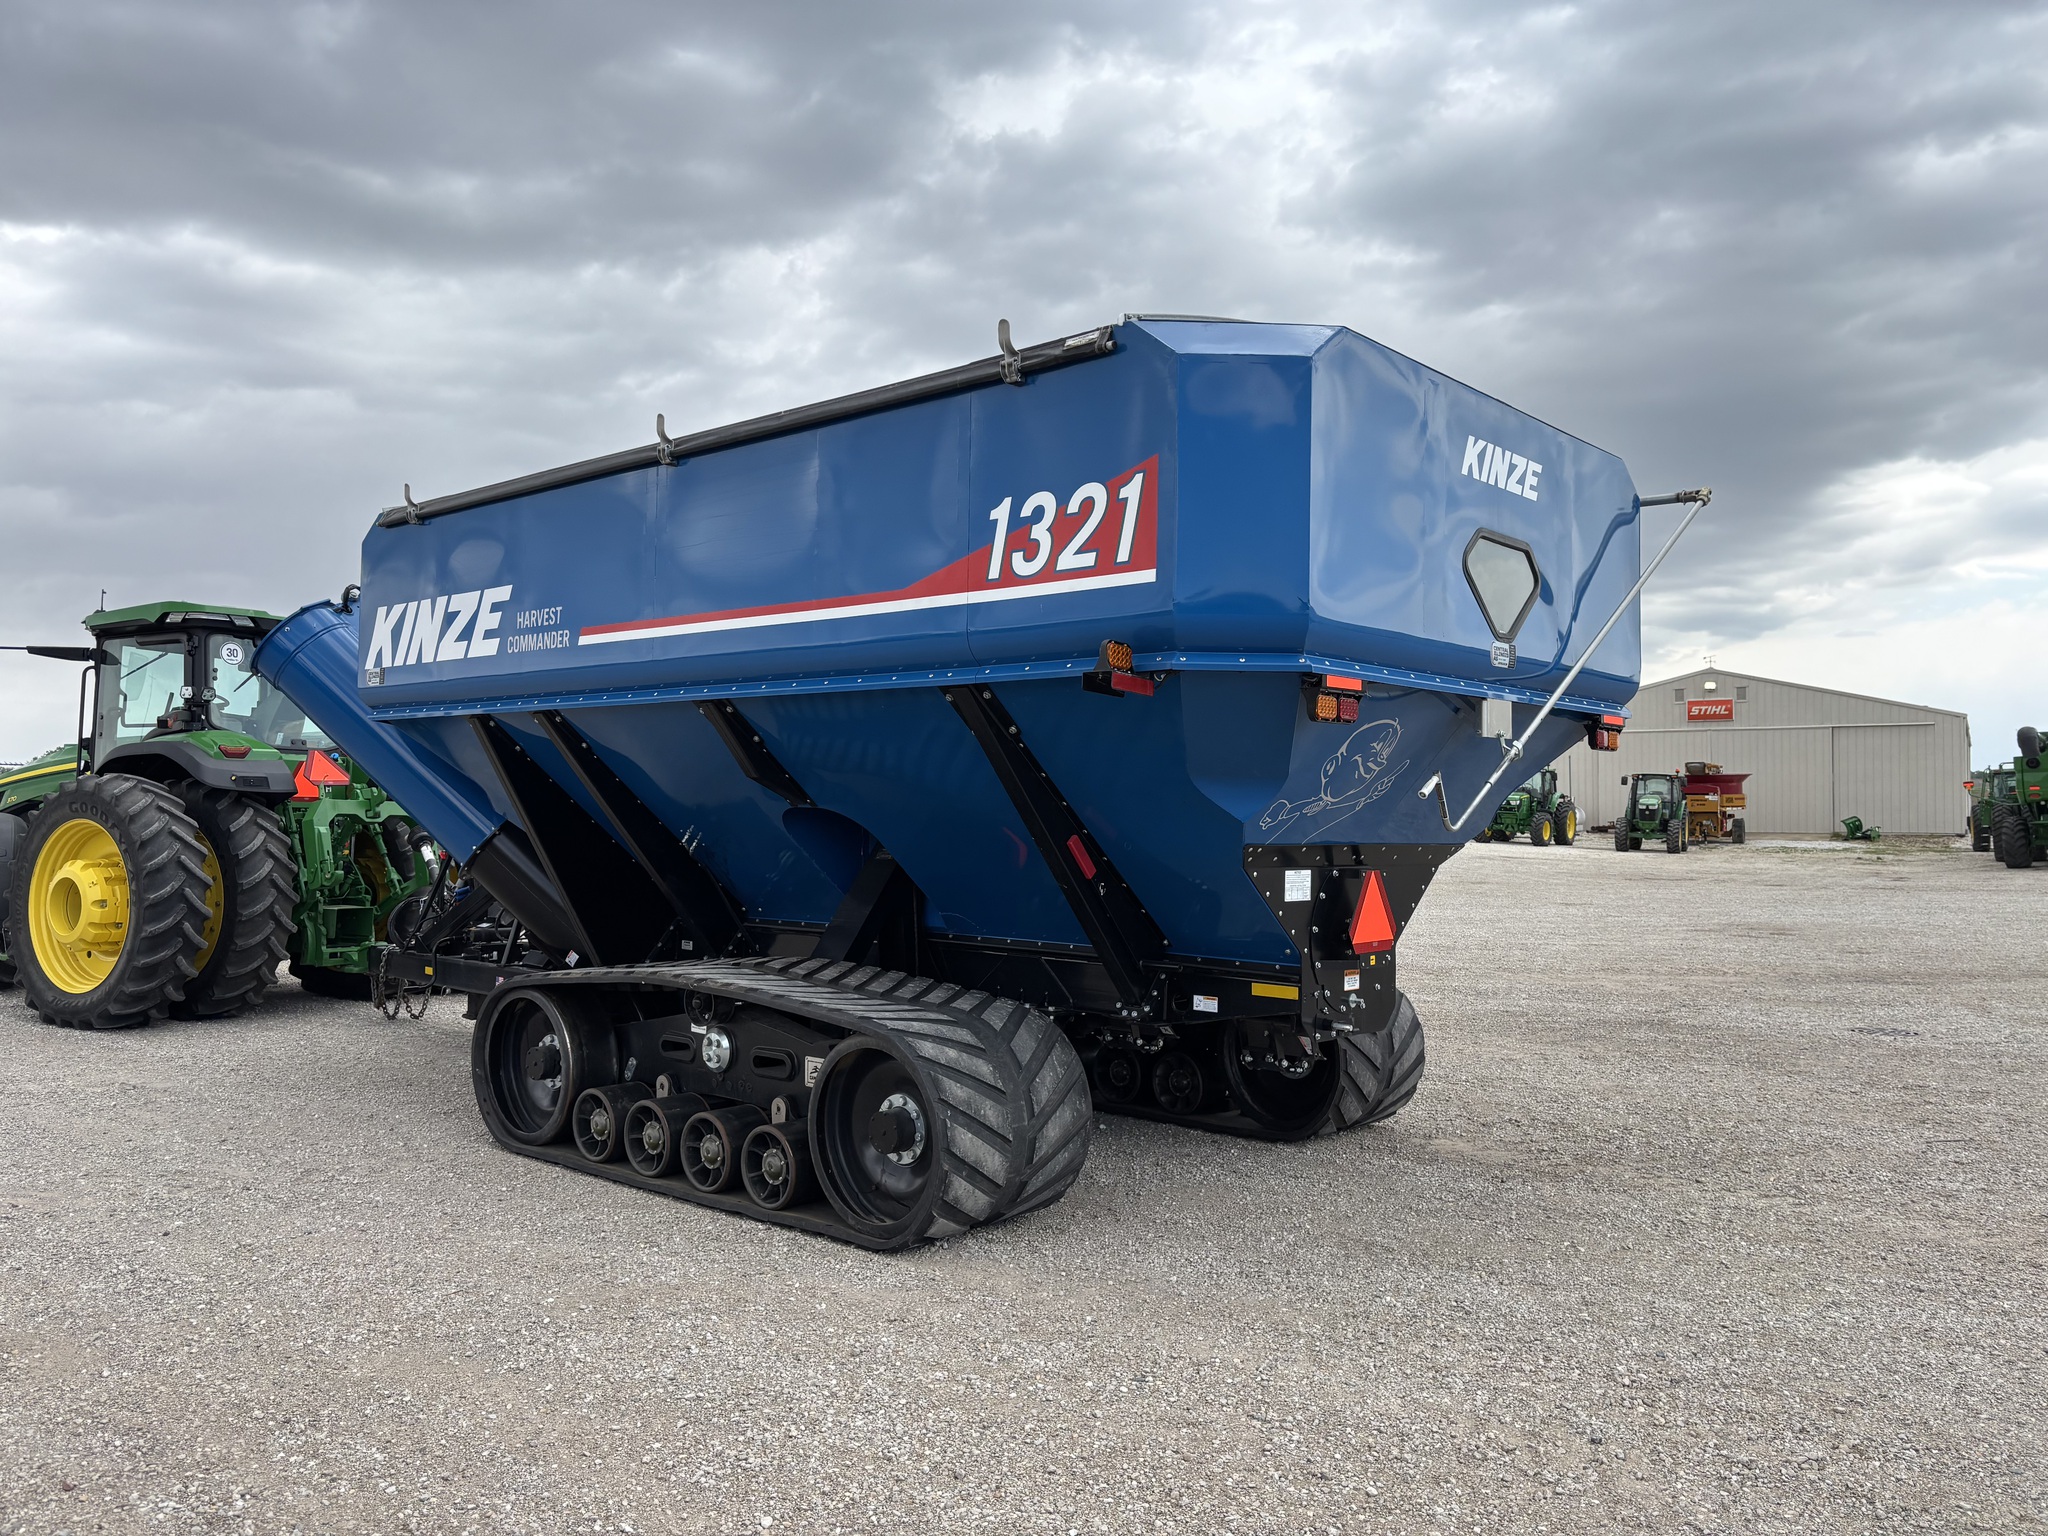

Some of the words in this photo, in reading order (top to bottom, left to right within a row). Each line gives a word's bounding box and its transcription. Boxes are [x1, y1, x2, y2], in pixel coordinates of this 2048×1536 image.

[1461, 434, 1543, 501] KINZE
[987, 472, 1144, 580] 1321
[364, 584, 513, 669] KINZE
[516, 606, 563, 630] HARVEST
[226, 647, 239, 658] 30
[507, 629, 570, 654] COMMANDER
[1689, 705, 1729, 716] STIHL
